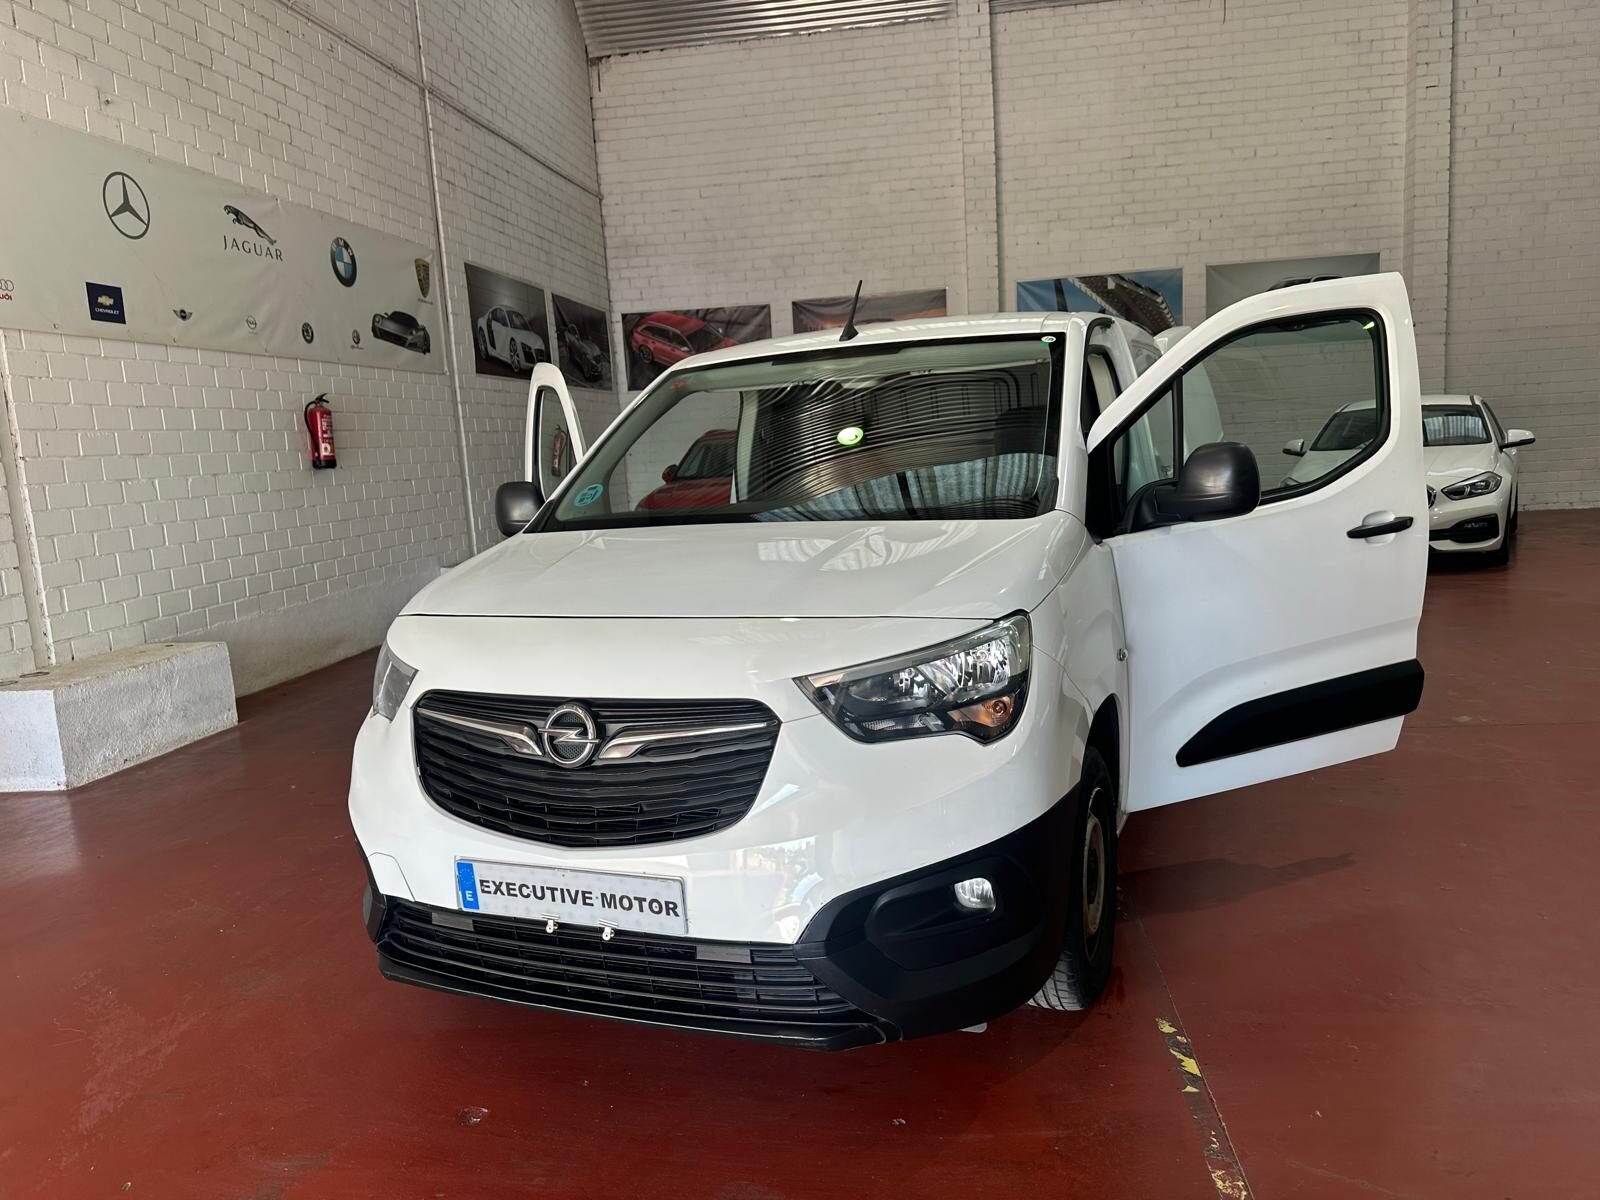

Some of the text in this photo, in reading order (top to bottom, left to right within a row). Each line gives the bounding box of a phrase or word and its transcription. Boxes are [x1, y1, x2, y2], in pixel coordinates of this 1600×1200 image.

[223, 235, 283, 262] JAGUAR
[465, 890, 474, 902] E
[479, 879, 680, 917] EXECUTIVE MOTOR
